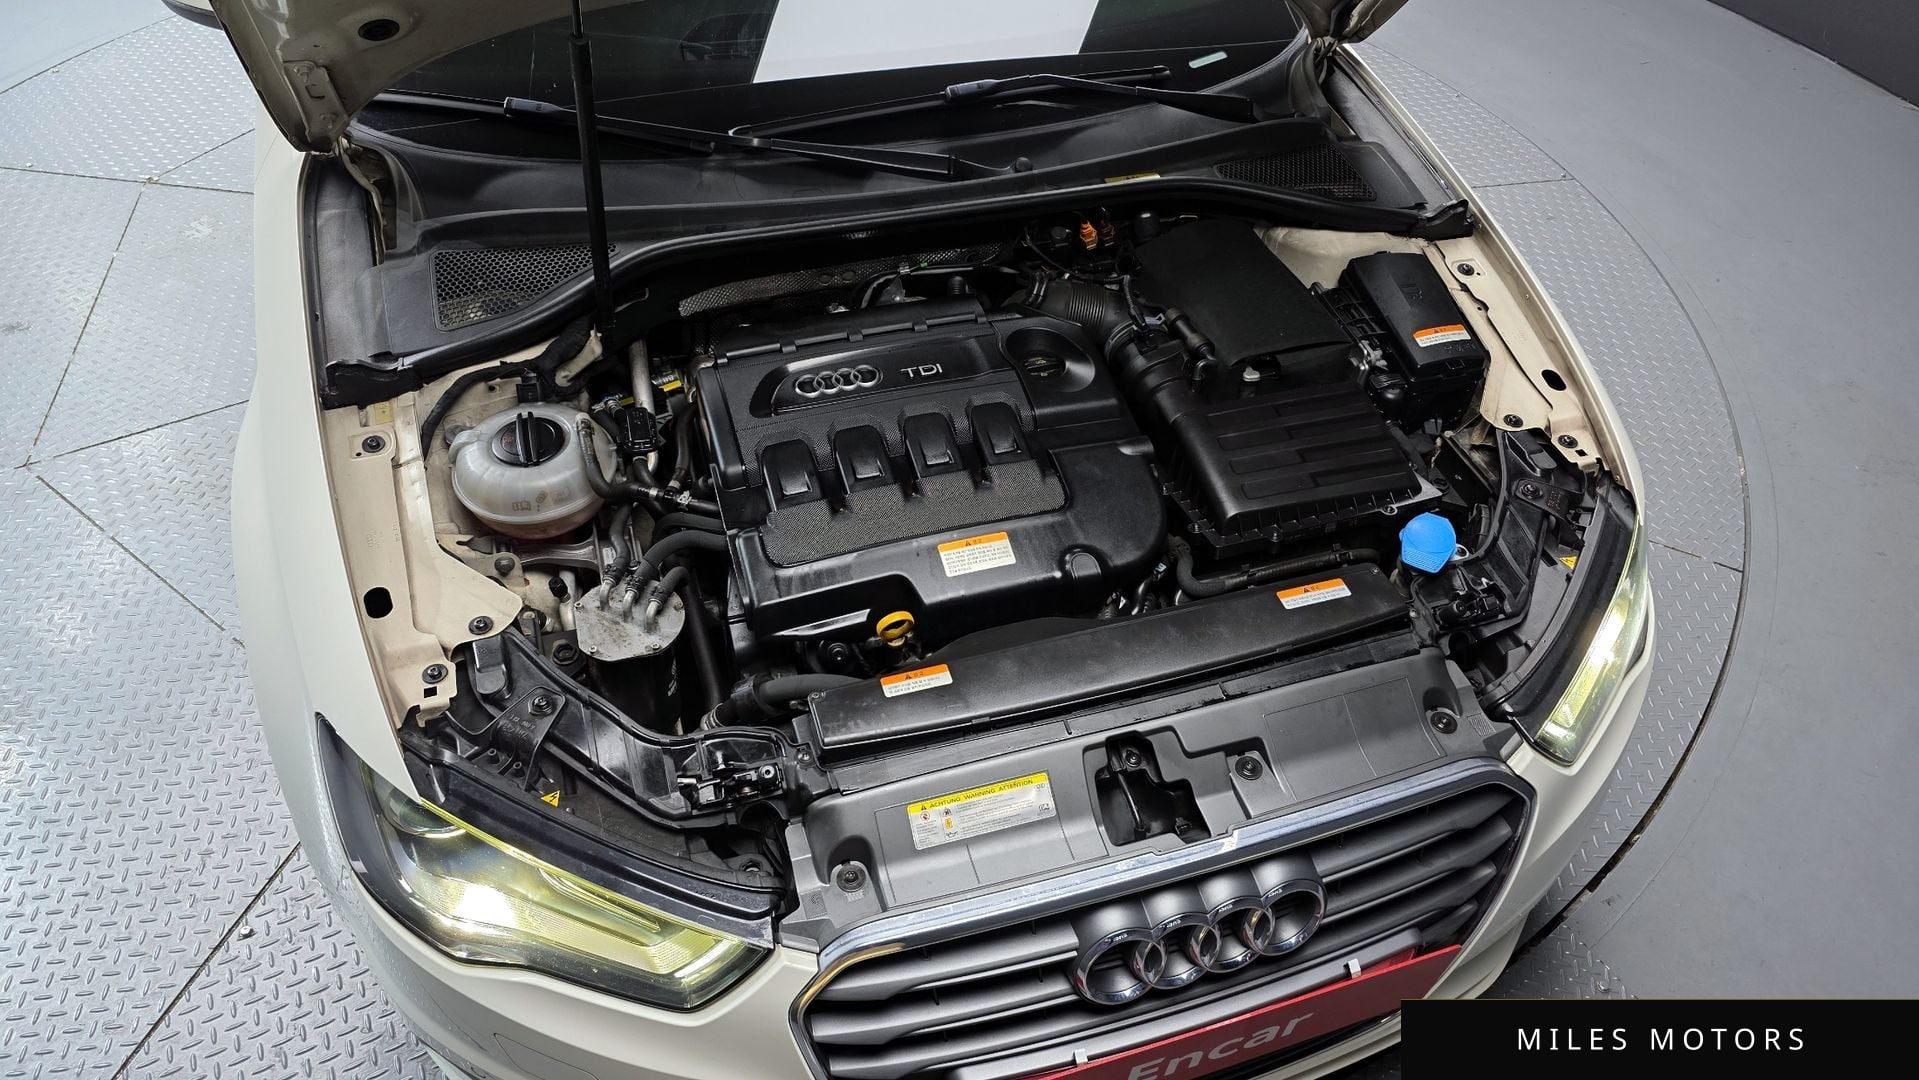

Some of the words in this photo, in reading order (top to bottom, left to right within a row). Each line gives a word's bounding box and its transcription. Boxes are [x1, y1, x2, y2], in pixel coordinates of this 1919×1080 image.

[901, 363, 942, 378] TDI
[929, 797, 961, 808] ACHTUNG
[964, 788, 996, 800] WARNING
[998, 779, 1034, 792] ATTENTION
[1127, 1012, 1314, 1080] Encar
